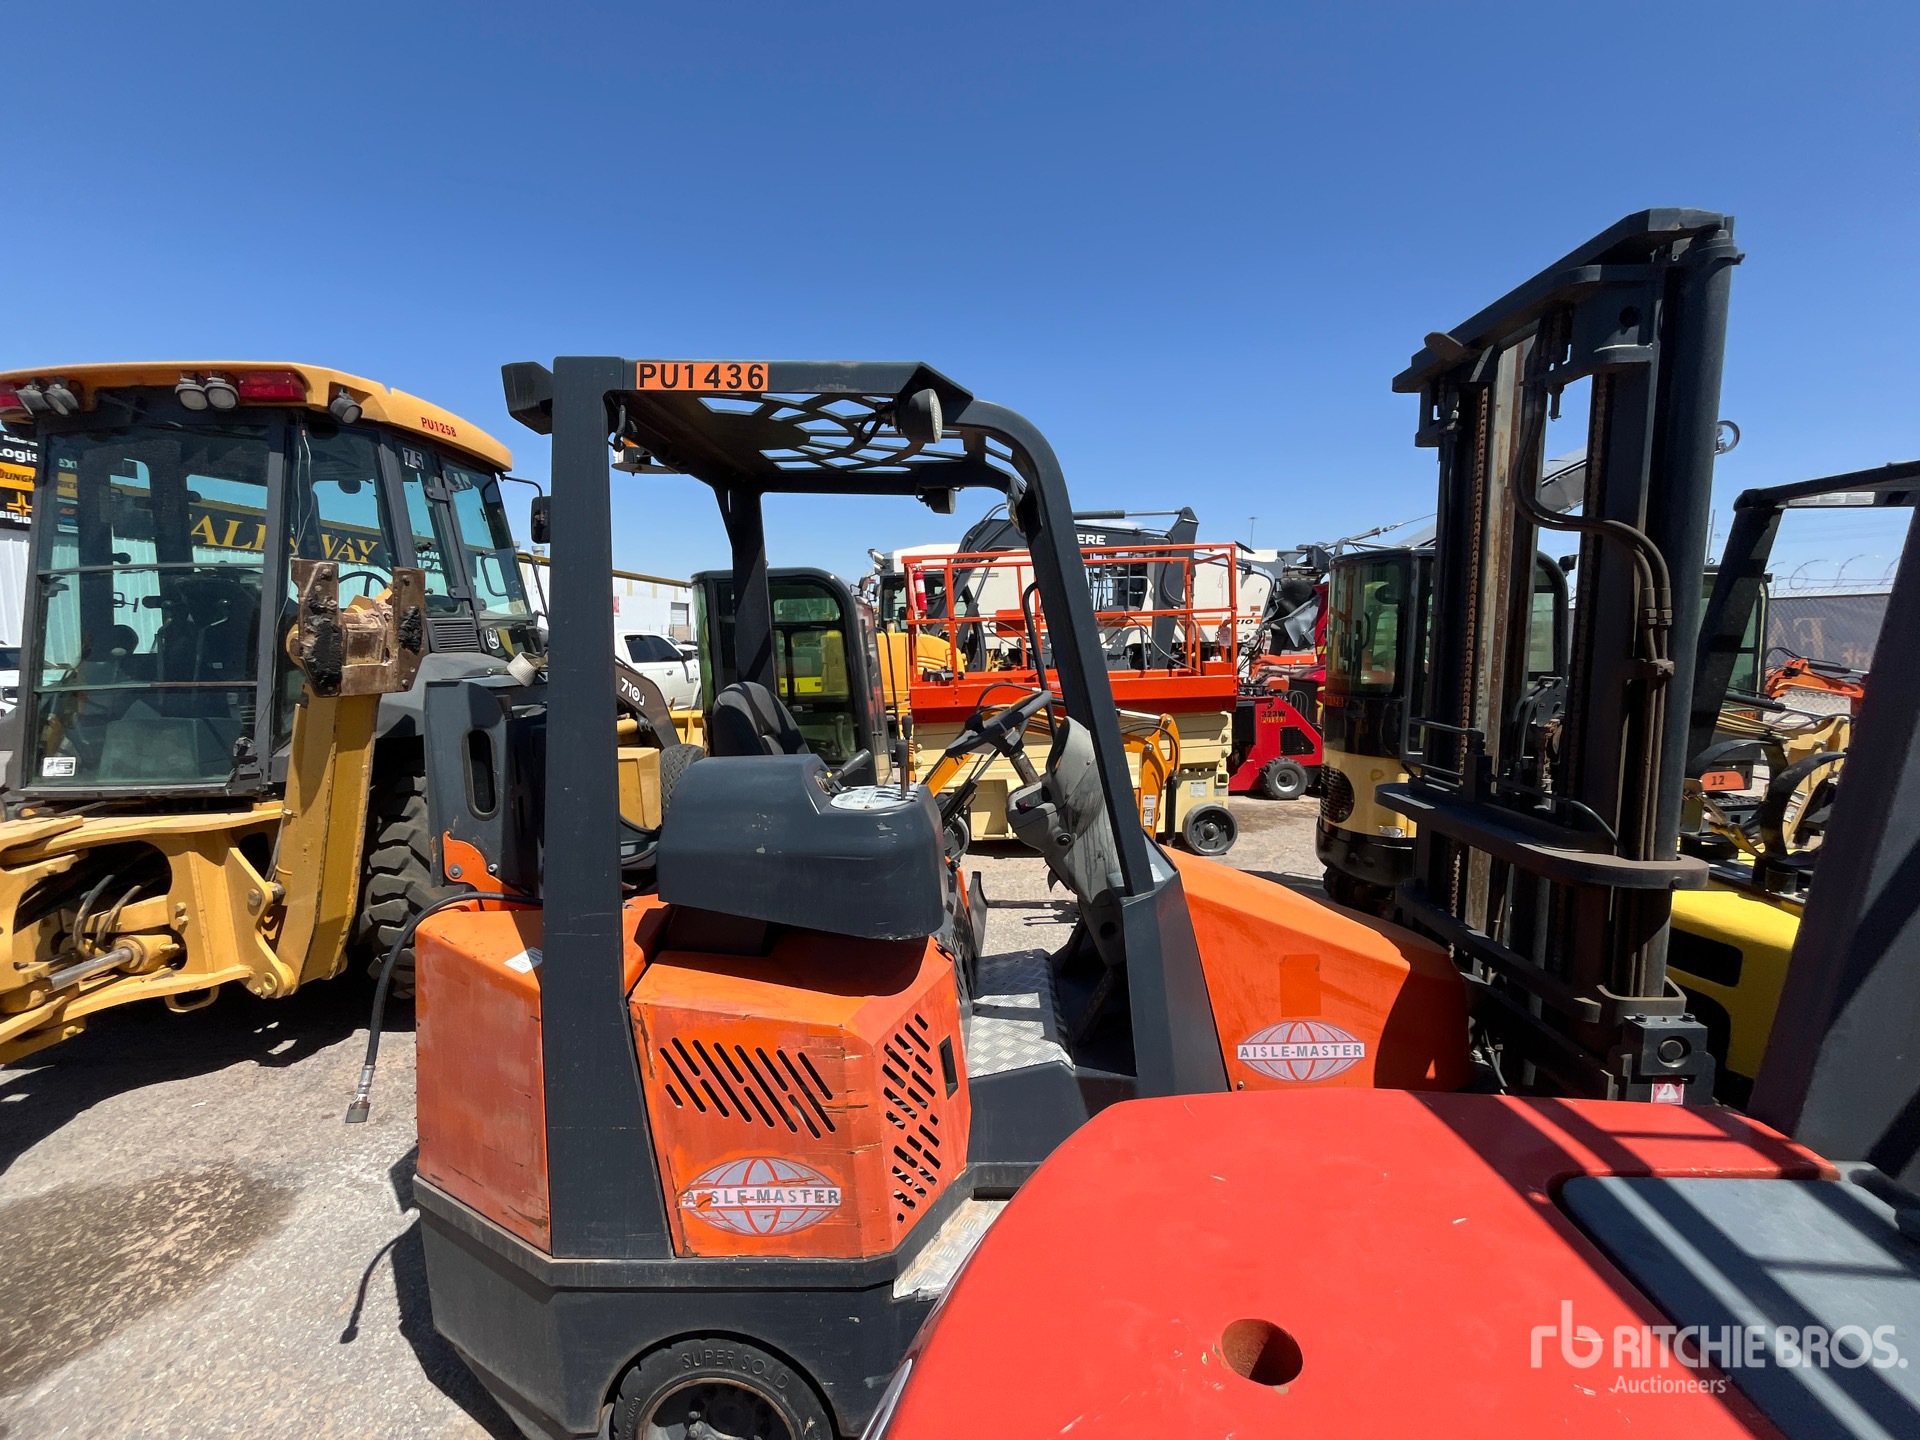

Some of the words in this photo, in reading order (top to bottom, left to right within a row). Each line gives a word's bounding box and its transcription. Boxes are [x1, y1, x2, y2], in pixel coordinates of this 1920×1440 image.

[639, 363, 764, 390] PU1436
[420, 417, 457, 437] PU1258
[1261, 710, 1286, 718] 323W
[1240, 1044, 1363, 1058] AISLE-MASTER
[685, 1188, 840, 1205] ASLE-MASTER
[681, 1349, 736, 1369] SUPER
